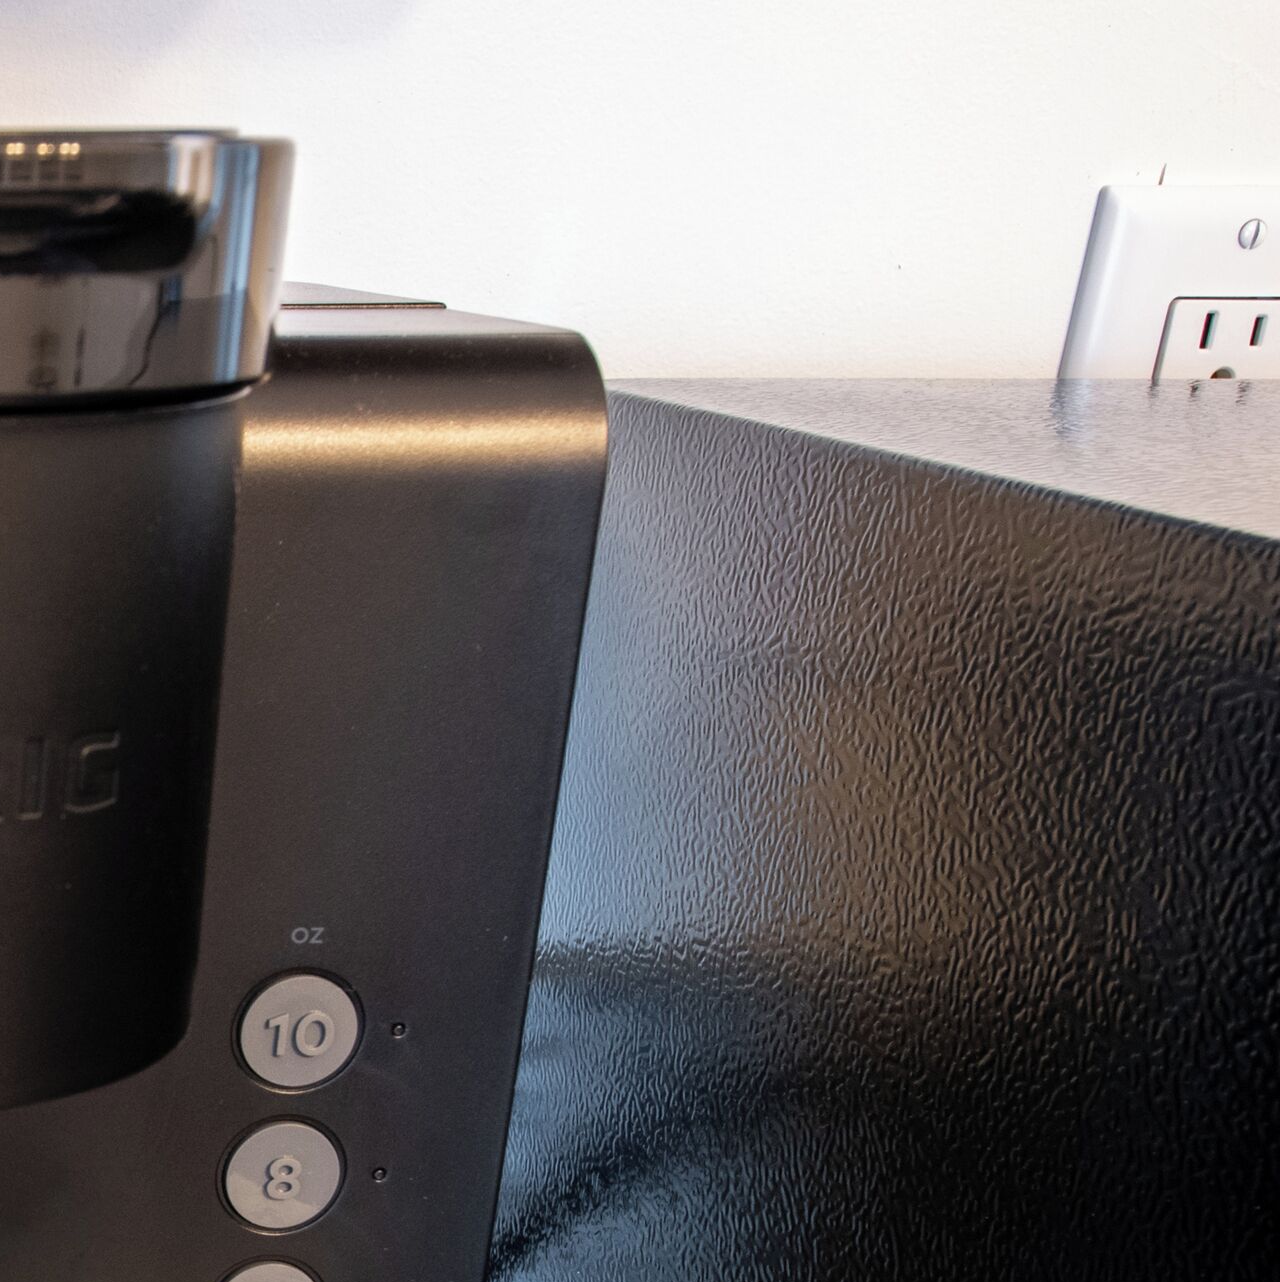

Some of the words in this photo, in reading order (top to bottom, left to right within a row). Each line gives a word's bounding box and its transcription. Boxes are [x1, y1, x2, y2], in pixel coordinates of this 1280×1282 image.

[290, 926, 325, 945] OZ
[264, 1009, 335, 1059] 10
[265, 1156, 303, 1201] 8
